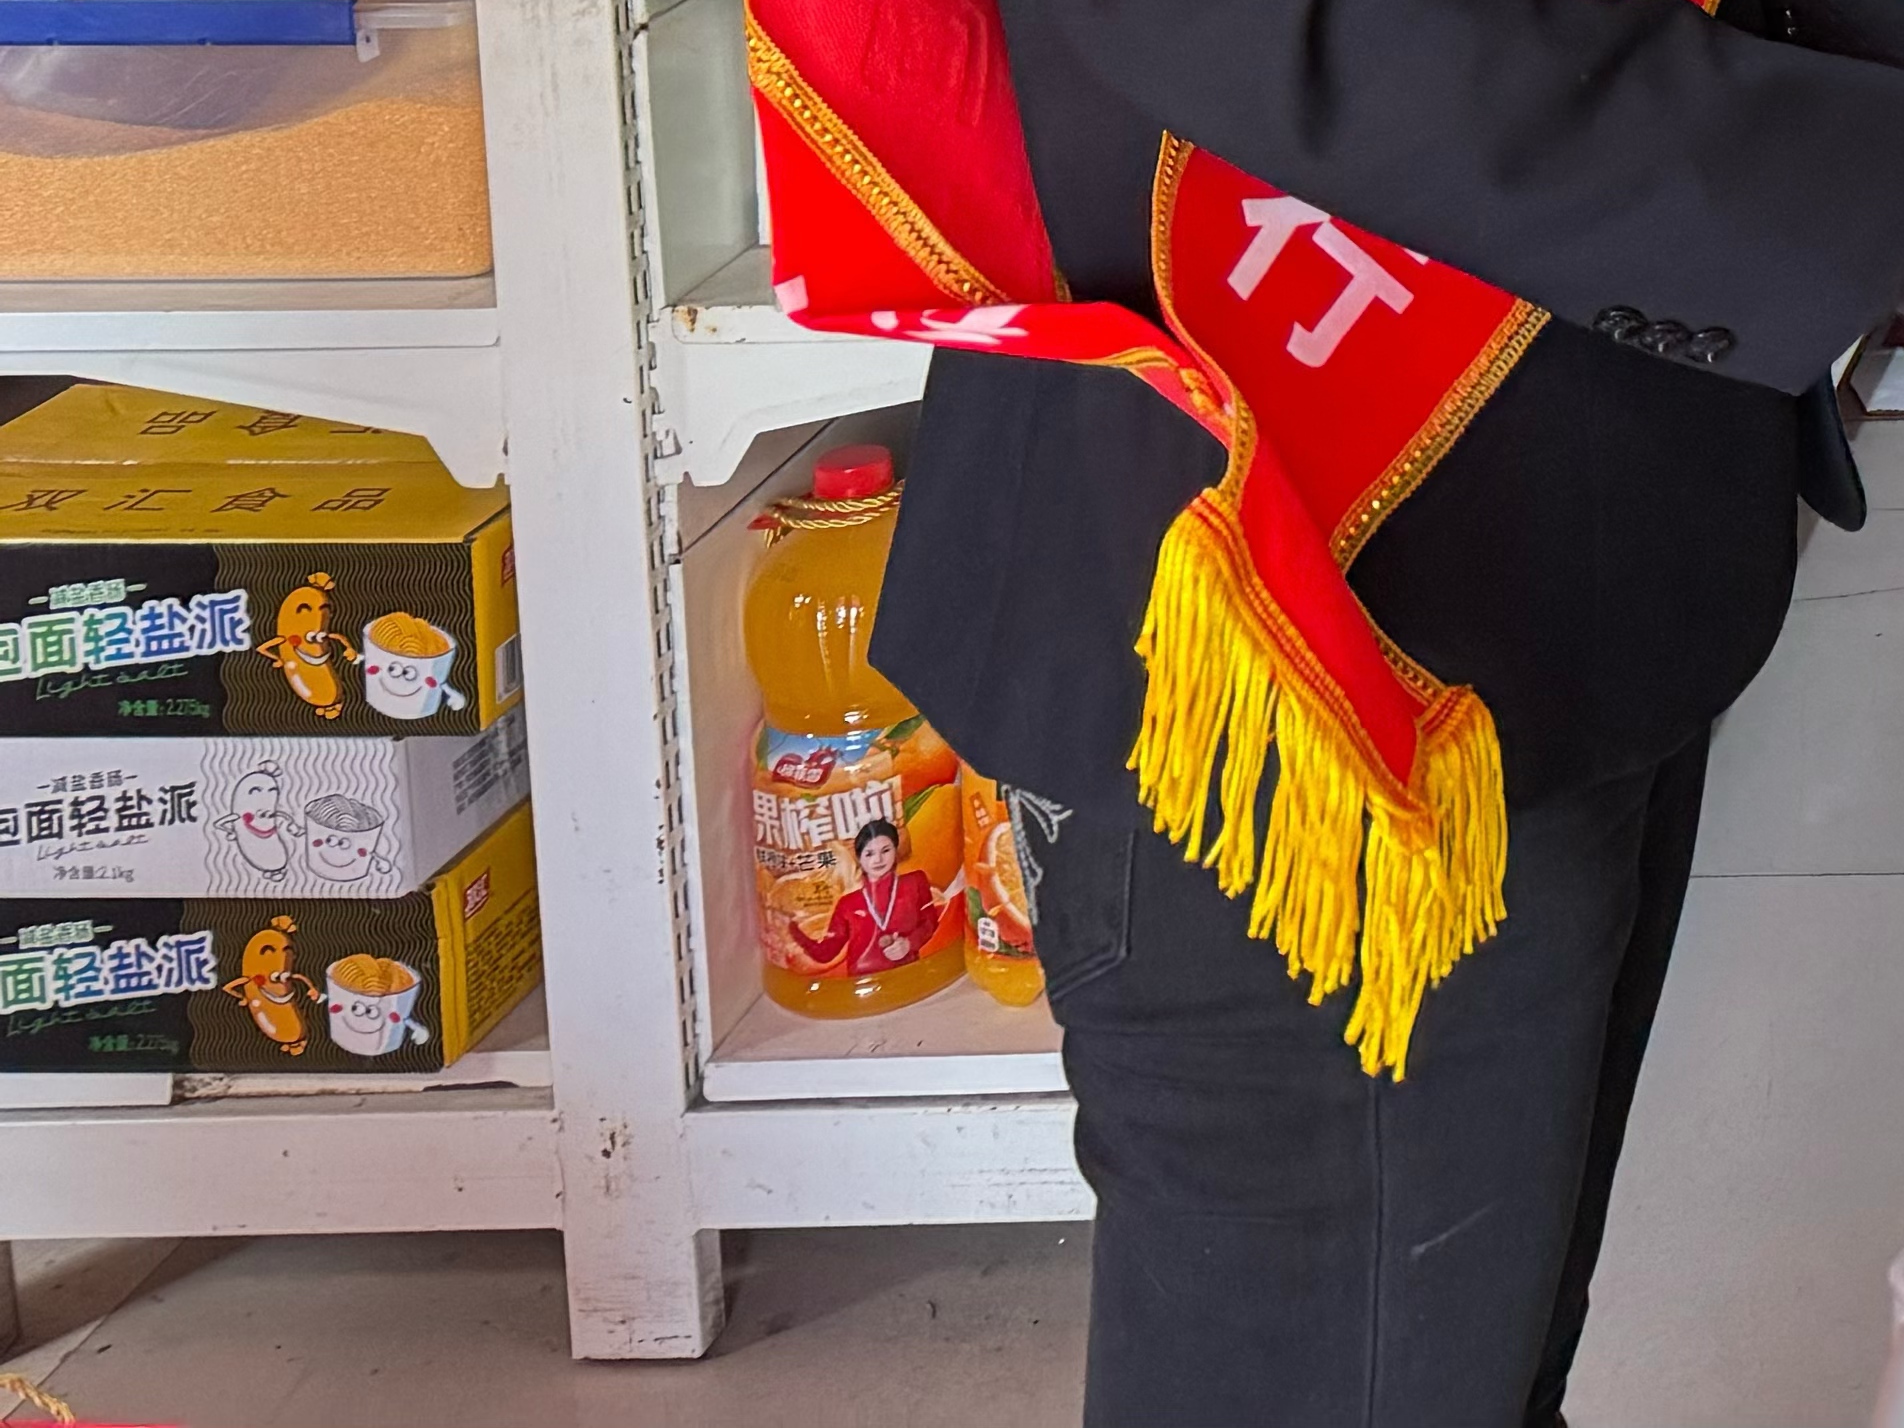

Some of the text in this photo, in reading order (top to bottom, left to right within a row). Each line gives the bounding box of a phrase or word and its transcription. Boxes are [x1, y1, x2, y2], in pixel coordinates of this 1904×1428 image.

[1226, 194, 1415, 369] 行
[2, 485, 393, 515] 双汇食品
